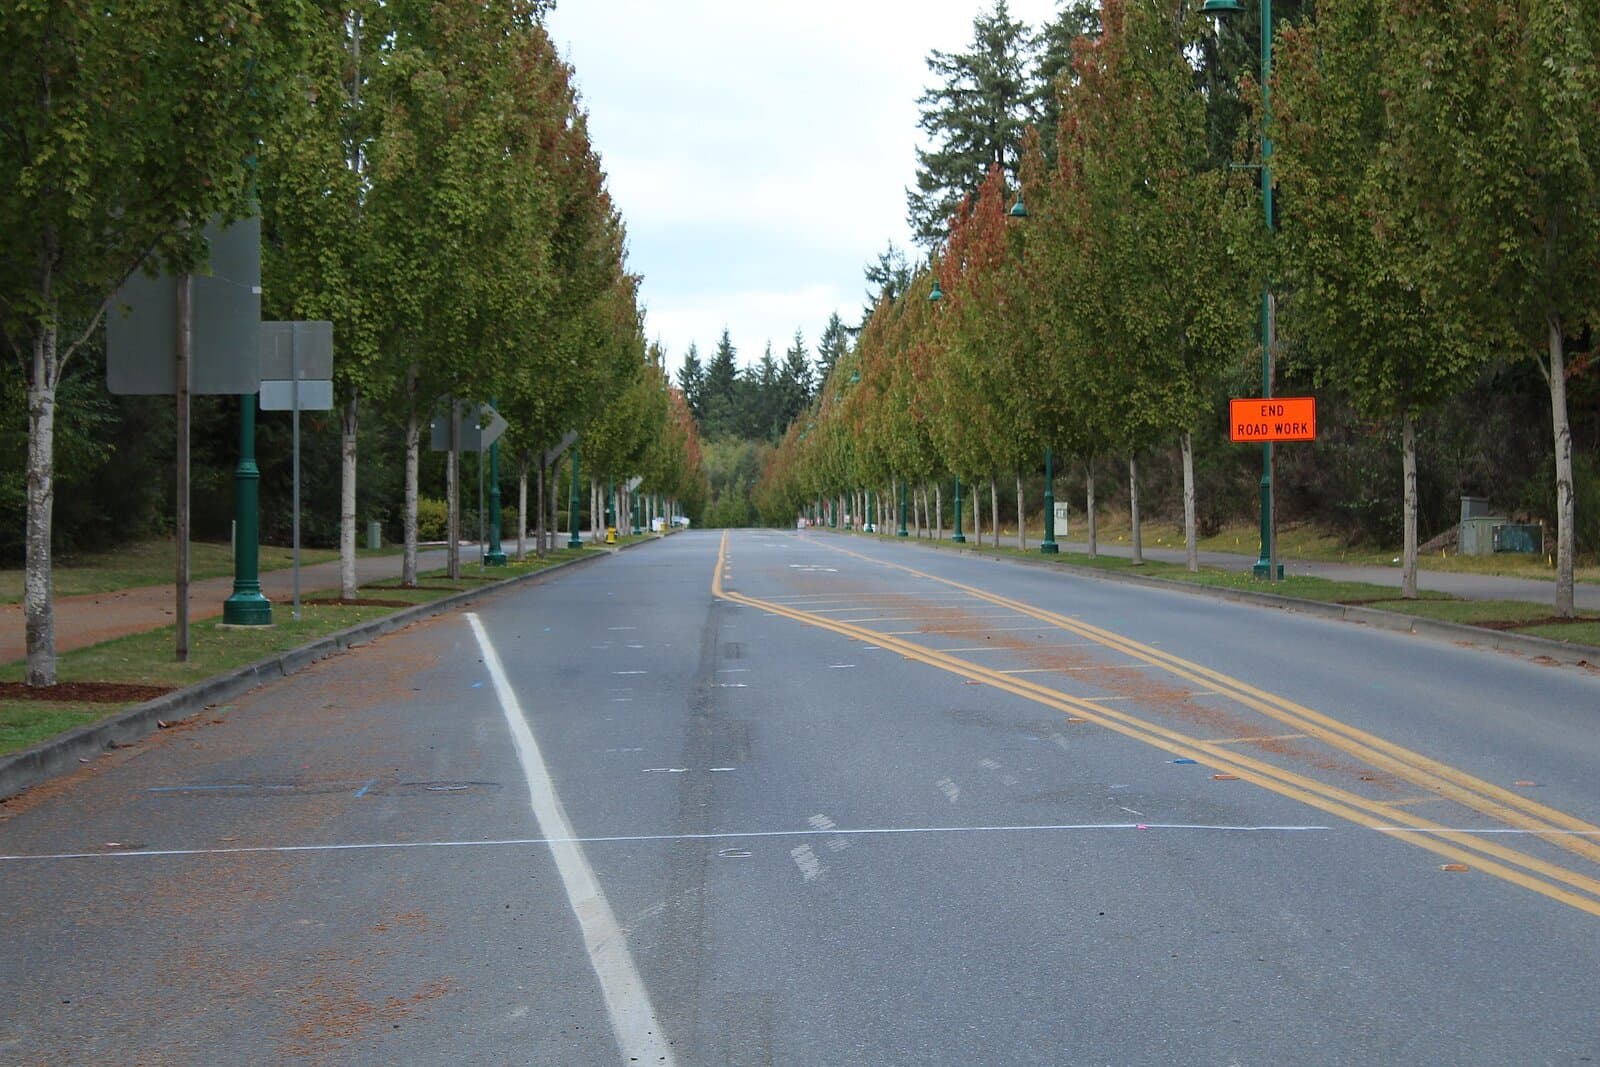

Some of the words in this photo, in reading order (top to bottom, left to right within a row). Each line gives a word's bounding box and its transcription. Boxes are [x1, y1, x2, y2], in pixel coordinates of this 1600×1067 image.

[1261, 405, 1284, 416] END
[1238, 423, 1268, 435] ROAD
[1275, 422, 1308, 434] WORK
